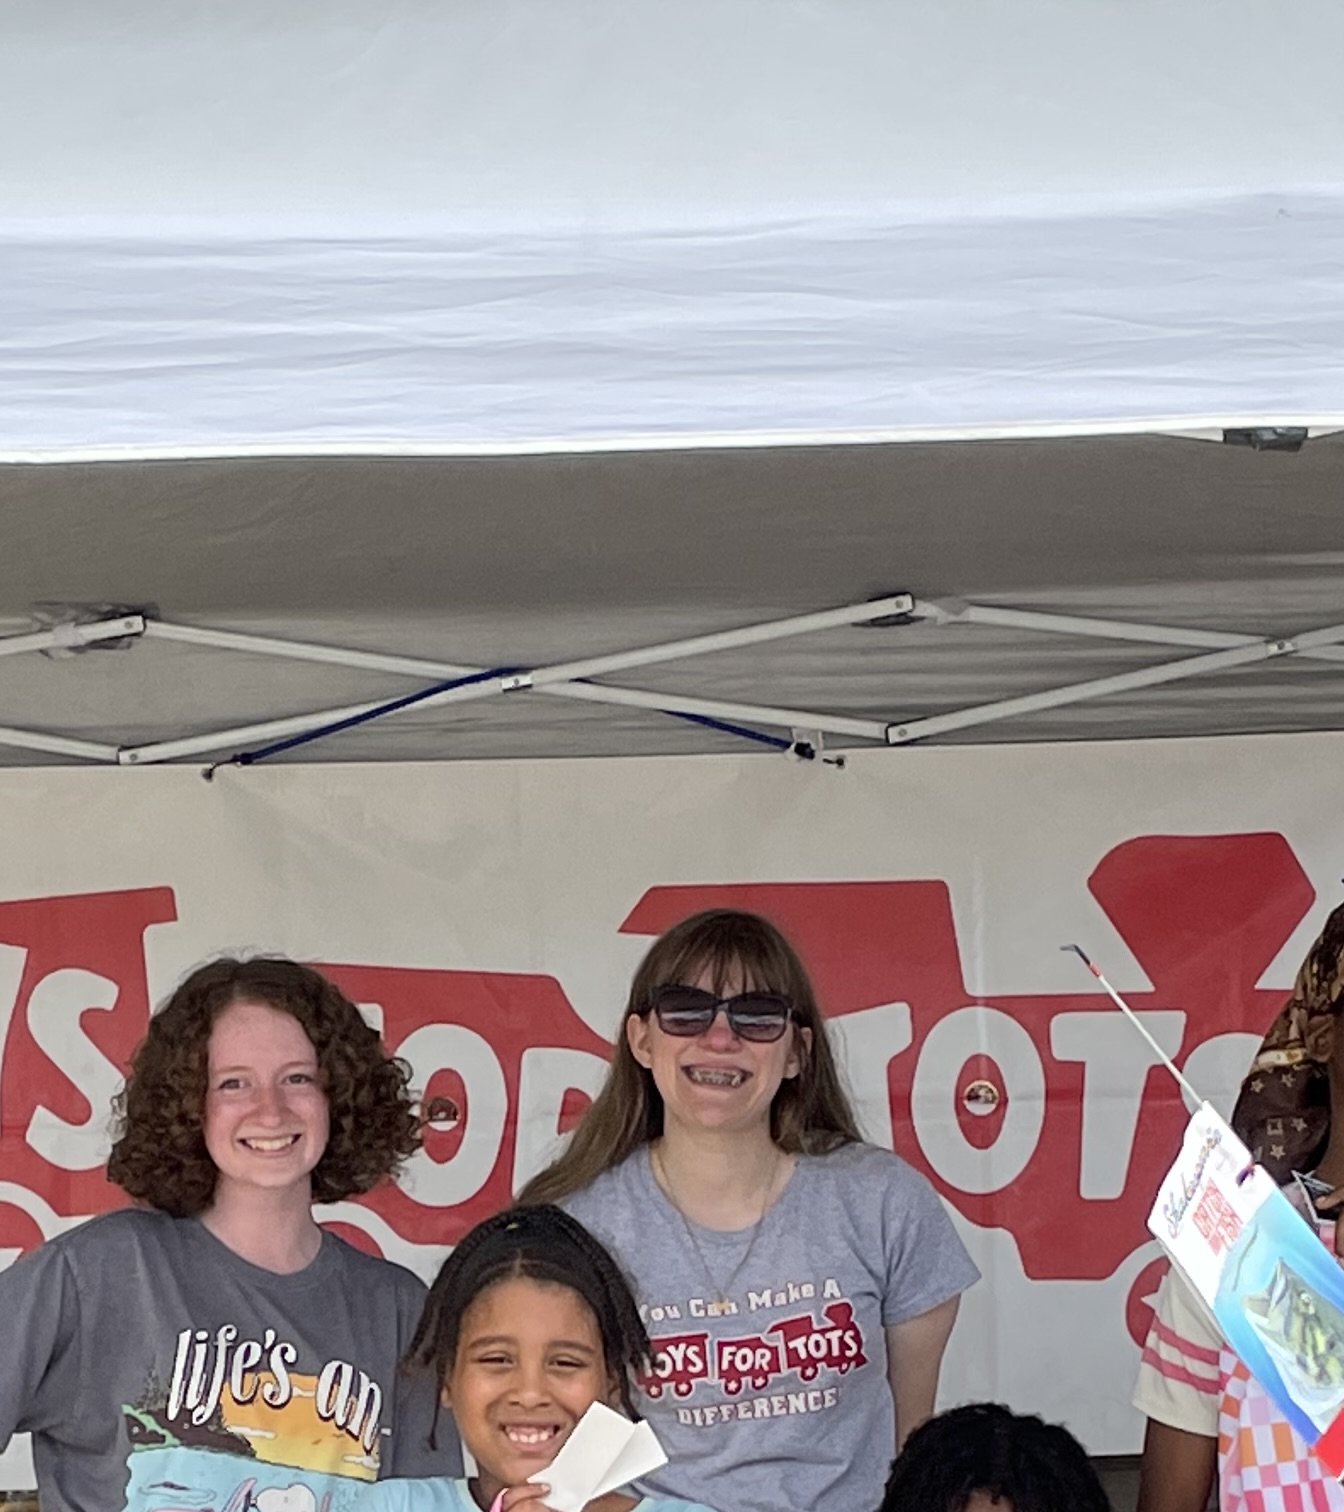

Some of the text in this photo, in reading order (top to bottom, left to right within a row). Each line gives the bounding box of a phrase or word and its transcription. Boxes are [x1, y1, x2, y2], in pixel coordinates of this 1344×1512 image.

[747, 1281, 816, 1312] Make
[822, 1278, 842, 1299] A
[720, 1345, 773, 1373] FOR
[787, 1329, 859, 1361] TOTS
[675, 1387, 840, 1427] DIFFERENCE
